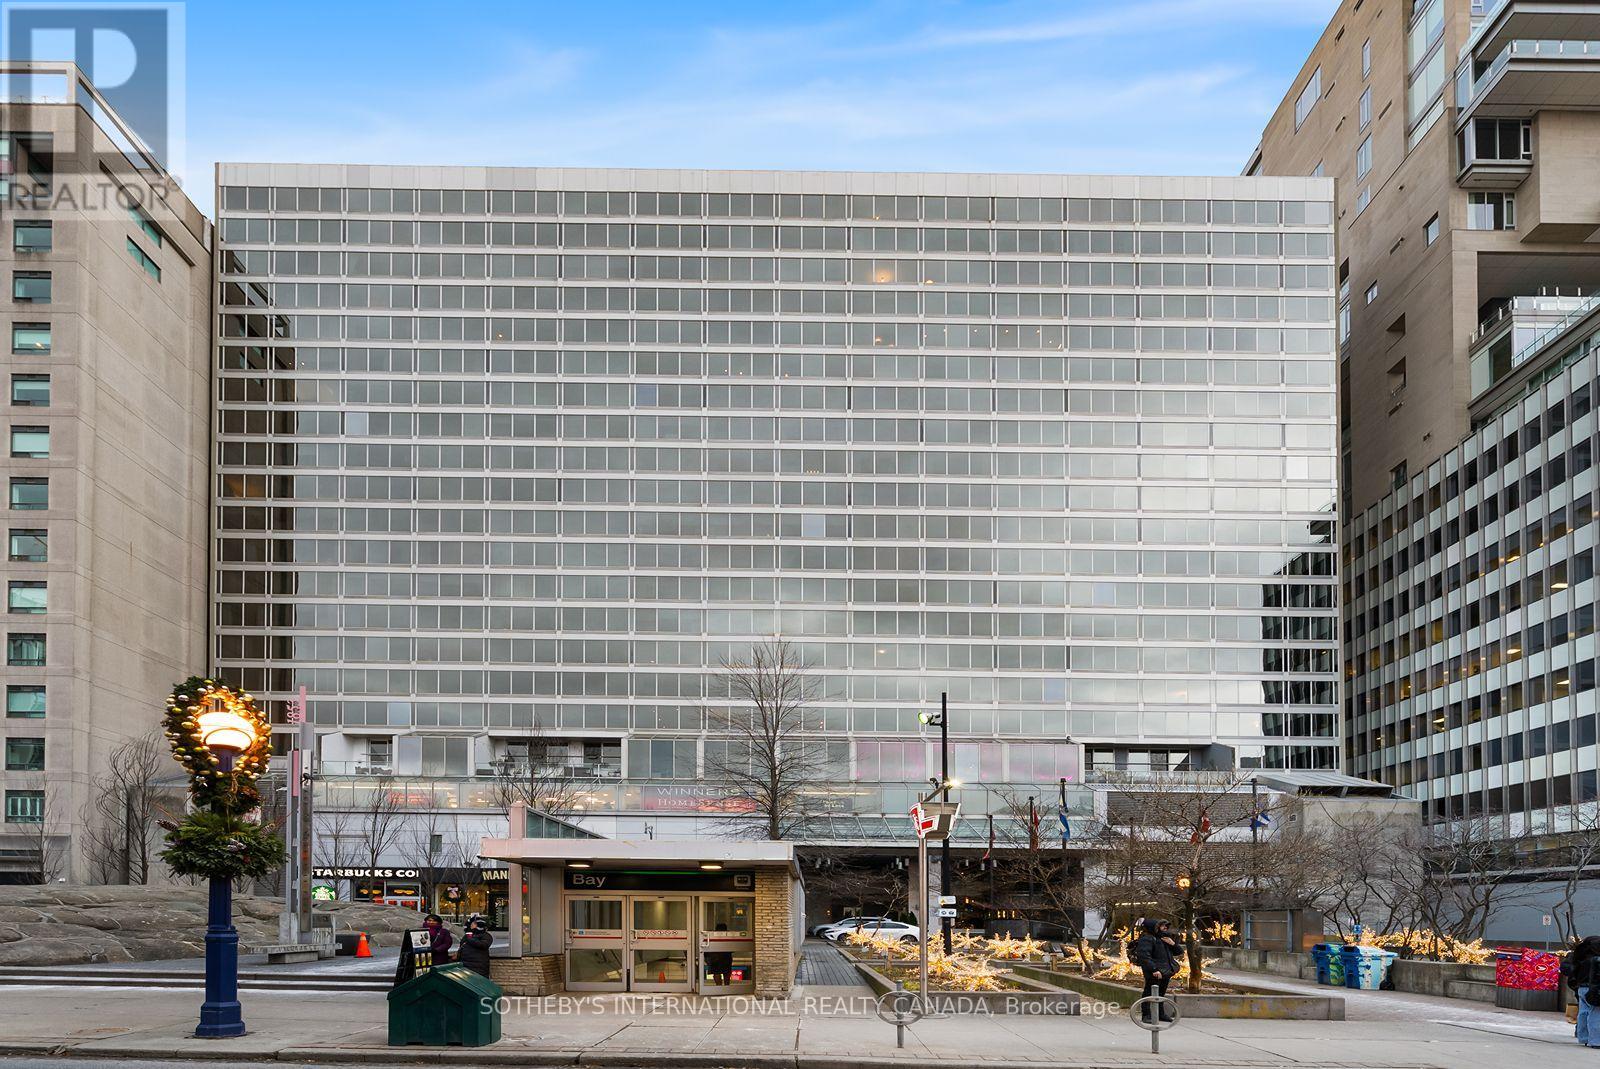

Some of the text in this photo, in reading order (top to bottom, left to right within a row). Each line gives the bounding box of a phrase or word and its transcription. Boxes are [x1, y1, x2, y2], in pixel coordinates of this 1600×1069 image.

[657, 787, 741, 796] WINNERS
[312, 868, 393, 877] TARBUCKS
[482, 870, 510, 880] MAN
[573, 873, 606, 888] Bay
